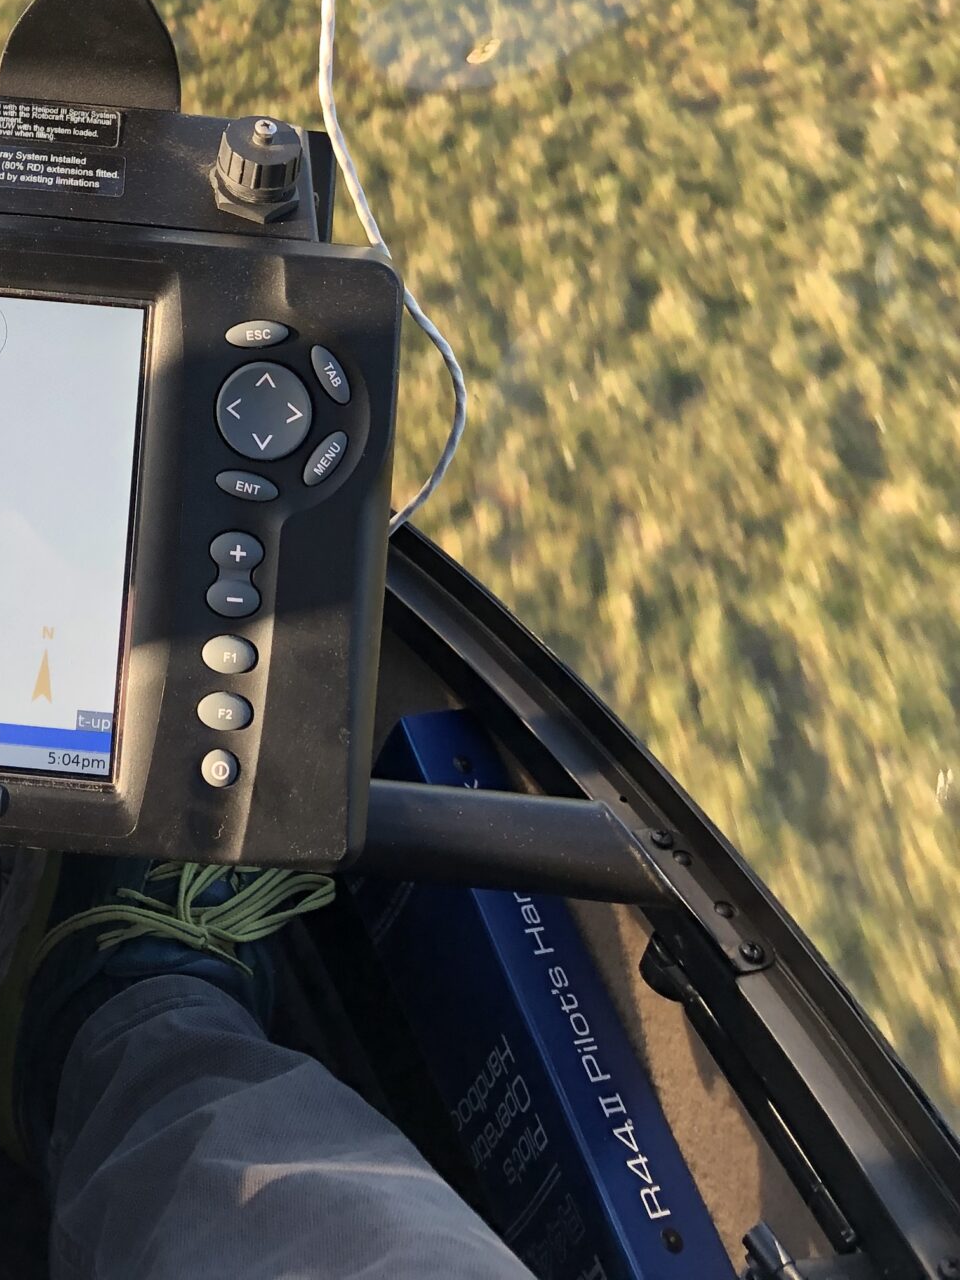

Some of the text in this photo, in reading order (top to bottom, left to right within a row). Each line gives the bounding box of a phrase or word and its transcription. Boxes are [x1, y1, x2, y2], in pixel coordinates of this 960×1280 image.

[15, 151, 48, 161] System
[50, 154, 87, 165] Installed
[2, 161, 24, 171] (80%
[26, 163, 44, 173] RD)
[46, 165, 94, 176] extensions
[95, 168, 120, 179] fitted.
[7, 172, 18, 182] by
[20, 174, 53, 185] existing
[55, 175, 100, 188] limitations
[246, 329, 272, 341] ESC
[323, 362, 342, 388] TAB
[313, 442, 341, 476] MENU
[235, 480, 261, 495] ENT
[43, 626, 55, 639] N
[223, 651, 237, 664] F1
[217, 708, 233, 720] F2
[48, 751, 106, 770] 5:04pm
[548, 963, 671, 1219] R44 II Pilot's
